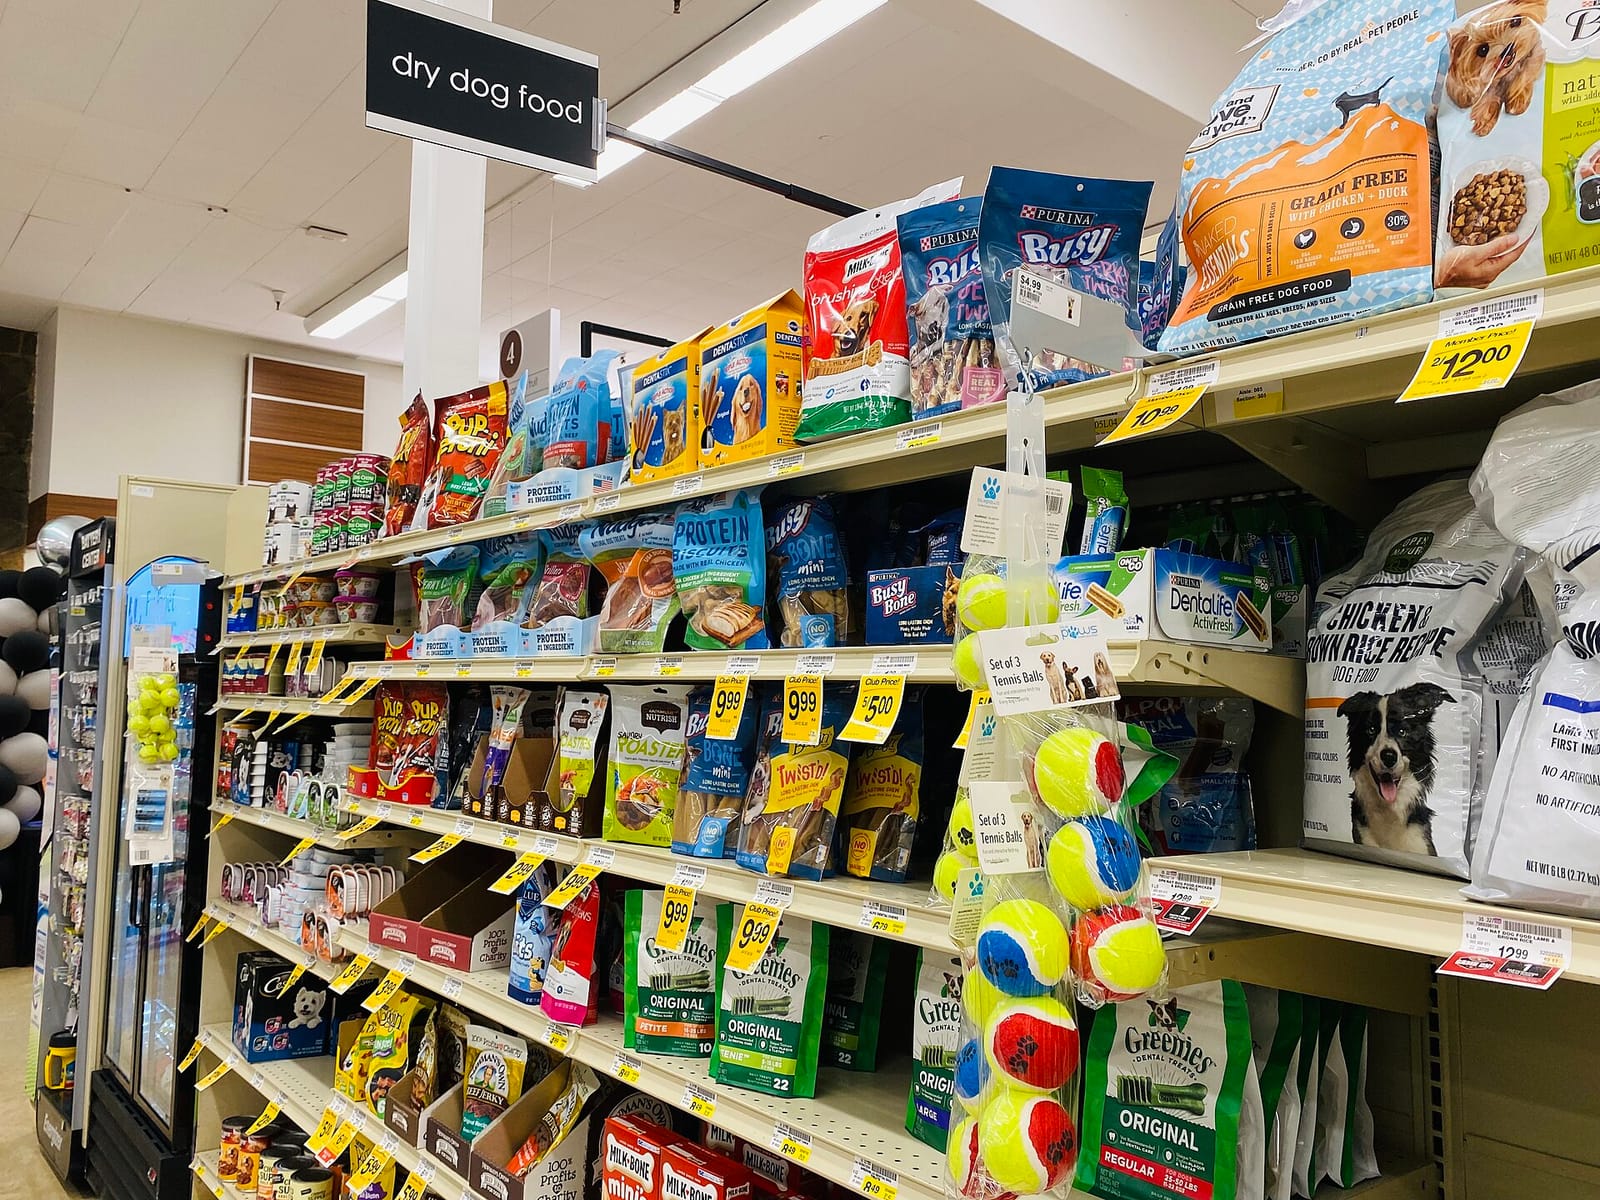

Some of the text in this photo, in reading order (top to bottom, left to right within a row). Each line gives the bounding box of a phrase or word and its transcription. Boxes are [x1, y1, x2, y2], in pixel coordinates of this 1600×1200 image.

[1317, 53, 1329, 64] CO
[1331, 47, 1341, 58] BY
[1343, 36, 1364, 52] REAL
[1368, 25, 1384, 39] PET
[1386, 9, 1419, 31] PEOPLE
[391, 52, 582, 124] dry dog food
[1226, 94, 1254, 108] and
[1577, 117, 1596, 129] Real
[1291, 169, 1408, 210] GRAIN FREE
[1288, 207, 1316, 223] WITH
[1319, 192, 1365, 214] CHICKEN
[1378, 186, 1409, 199] DUCK
[1037, 209, 1091, 226] PURINA
[1387, 215, 1410, 227] 30%
[1194, 215, 1237, 258] NAKED
[1021, 227, 1112, 267] Busy
[1200, 228, 1250, 292] ESSENTIALS
[1019, 274, 1042, 291] $4.99
[1217, 279, 1333, 314] GRAIN FREE DOG FOOD
[1255, 311, 1265, 321] ALL
[506, 341, 516, 365] 4
[712, 333, 749, 358] DENTASTIX
[643, 364, 672, 387] DENTASTIX
[971, 378, 996, 387] REAL
[352, 486, 372, 495] HIGH
[527, 484, 562, 497] PROTEIN
[534, 492, 572, 504] INGREDIENT
[675, 515, 749, 547] PROTEIN
[787, 532, 836, 567] BONE
[798, 559, 825, 576] mini
[1119, 557, 1133, 568] ON
[1128, 561, 1143, 573] GO
[1177, 576, 1200, 588] PURINA
[872, 579, 908, 605] Busy
[884, 592, 915, 617] Bone
[1193, 614, 1234, 632] ActivFresh
[1327, 600, 1424, 633] CHICKEN
[811, 623, 825, 634] NO
[427, 641, 448, 650] PROTEIN
[472, 637, 500, 646] PROTEIN
[536, 634, 566, 644] PROTEIN
[1348, 632, 1390, 665] RICE
[989, 657, 1004, 671] Set
[1005, 656, 1015, 669] of
[993, 669, 1044, 688] Tennis Balls
[1333, 665, 1379, 683] DOG FOOD
[645, 712, 678, 724] NUTRISH
[703, 741, 743, 768] BONE
[712, 764, 732, 780] mini
[979, 813, 993, 826] Set
[853, 840, 866, 851] NO
[980, 831, 1023, 844] Tennis Balls
[1526, 860, 1537, 873] NET
[1538, 861, 1550, 875] WT
[1557, 865, 1566, 879] LB
[1567, 866, 1585, 883] (2.72
[483, 936, 508, 949] Profits
[479, 950, 508, 963] Charity
[656, 955, 707, 968] DENTAL TREATS
[741, 977, 790, 994] DENTAL TREATS
[650, 994, 704, 1011] ORIGINAL
[639, 1022, 668, 1033] PETITE
[728, 1019, 783, 1041] ORIGINAL
[699, 1042, 712, 1053] 10
[1125, 1026, 1213, 1074] Greenies
[838, 1051, 852, 1064] 22
[1136, 1054, 1196, 1079] DENTAL TREATS
[773, 1077, 790, 1091] 22
[1119, 1109, 1200, 1151] ORIGINAL
[1104, 1150, 1155, 1178] REGULAR
[540, 1169, 577, 1187] Profits
[1164, 1174, 1199, 1192] 25-50 LBS
